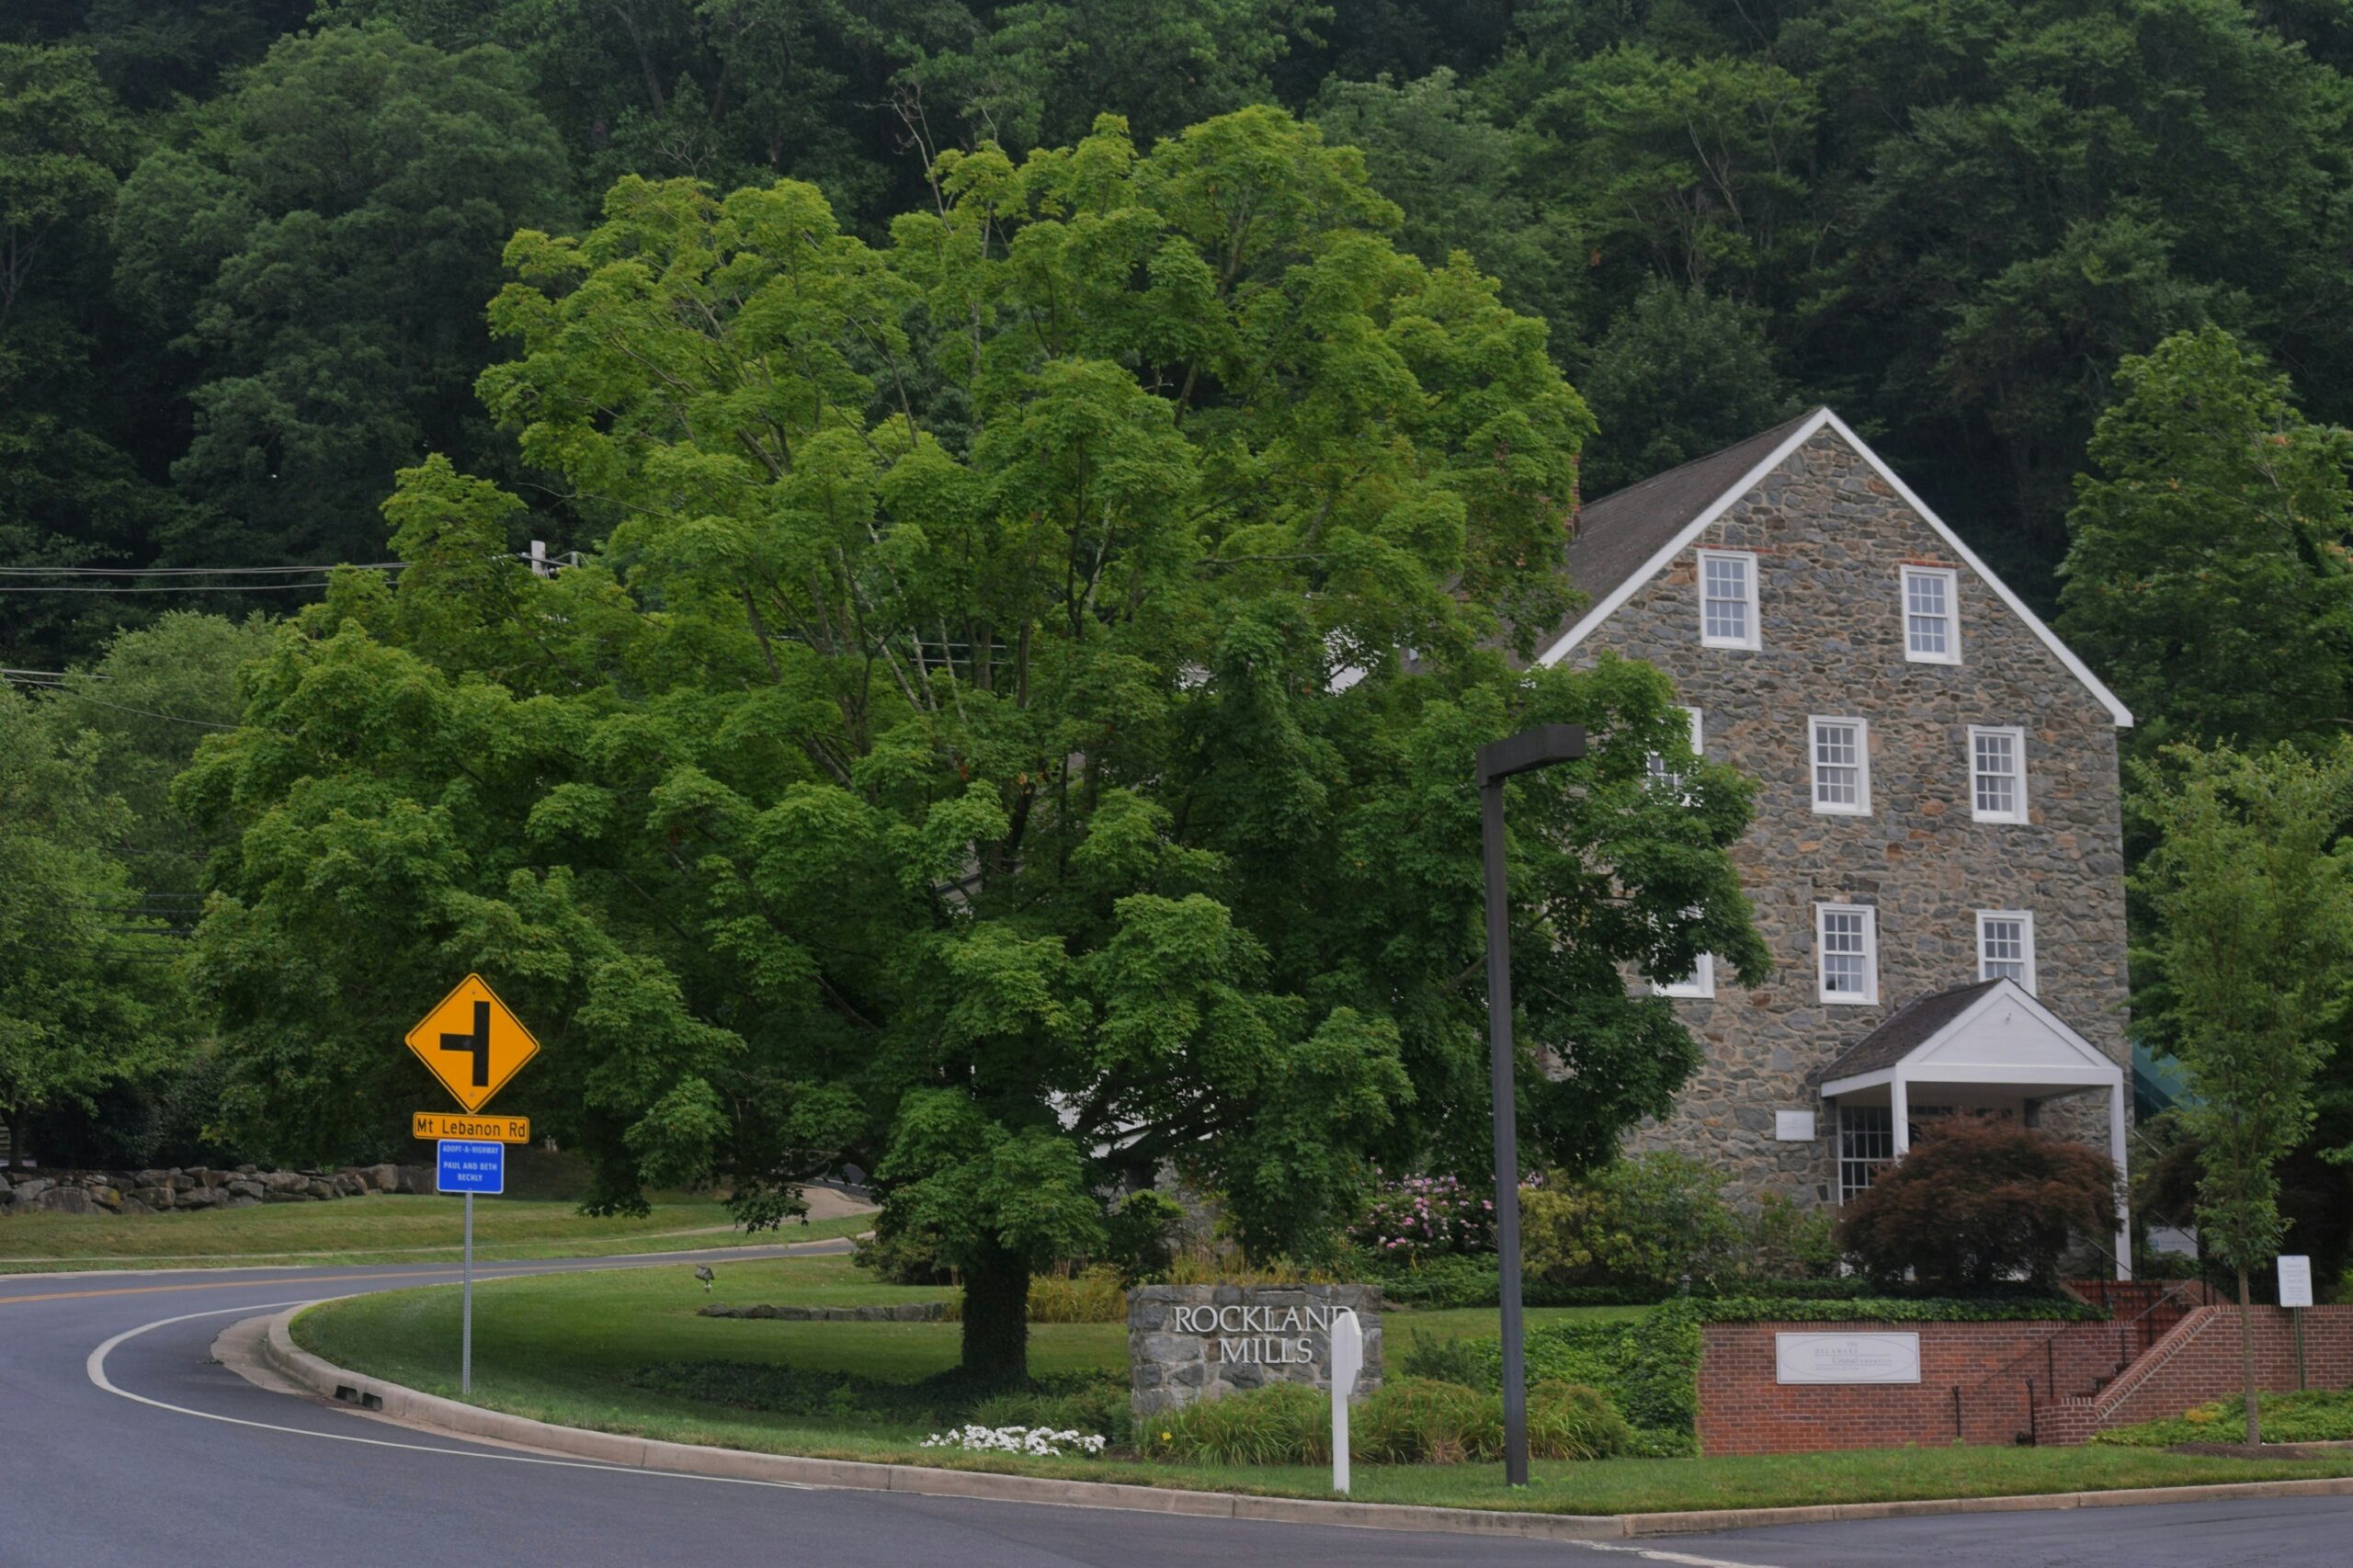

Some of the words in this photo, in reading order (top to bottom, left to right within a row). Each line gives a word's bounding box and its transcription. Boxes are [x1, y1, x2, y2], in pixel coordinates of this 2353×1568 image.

[416, 1119, 433, 1132] Mt
[442, 1119, 501, 1136] Lebanon
[509, 1122, 525, 1137] Rd
[480, 1163, 497, 1171] BETH
[1220, 1337, 1313, 1364] MILLS
